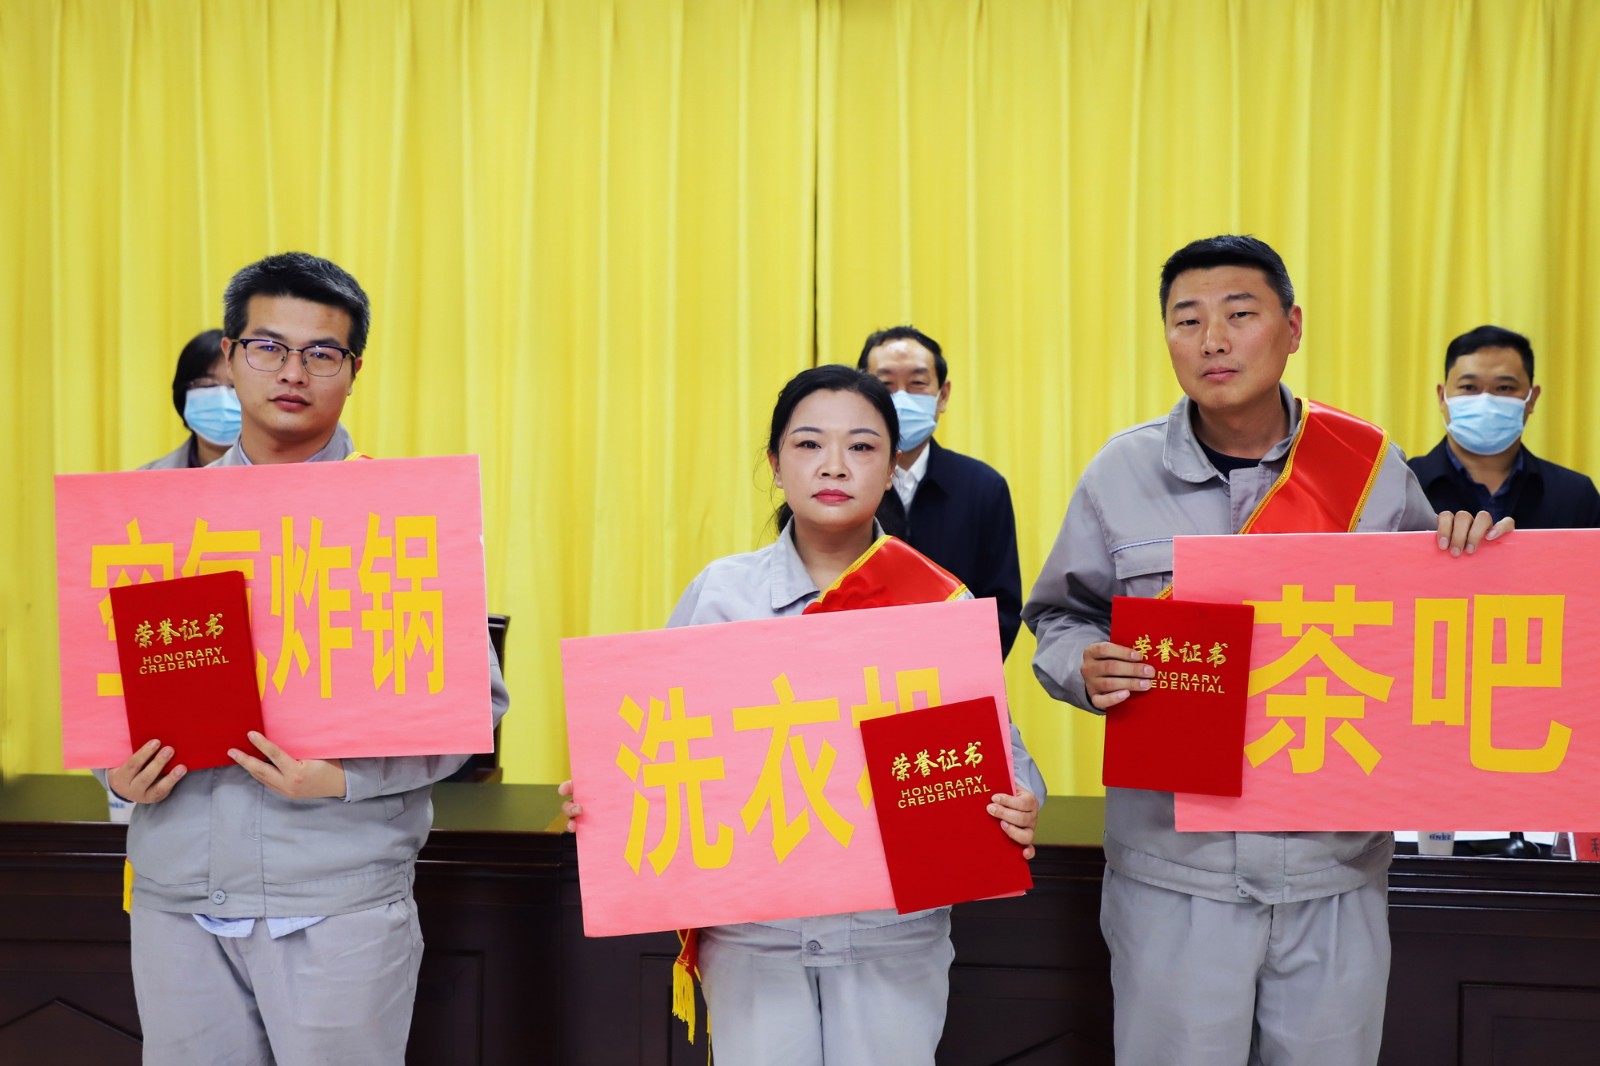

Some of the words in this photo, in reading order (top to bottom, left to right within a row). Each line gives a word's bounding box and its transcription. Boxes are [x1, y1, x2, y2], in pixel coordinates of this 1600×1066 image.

[134, 612, 225, 649] 荣誉证书
[139, 655, 230, 675] CREDENTIAL
[142, 646, 222, 665] HONORARY
[1151, 679, 1226, 694] EDENTIAL
[1157, 670, 1221, 684] NORARY
[1242, 584, 1573, 776] 茶吧
[891, 741, 984, 782] 荣誉证书
[898, 783, 991, 809] CREDENTIAL
[901, 774, 983, 799] HONORARY
